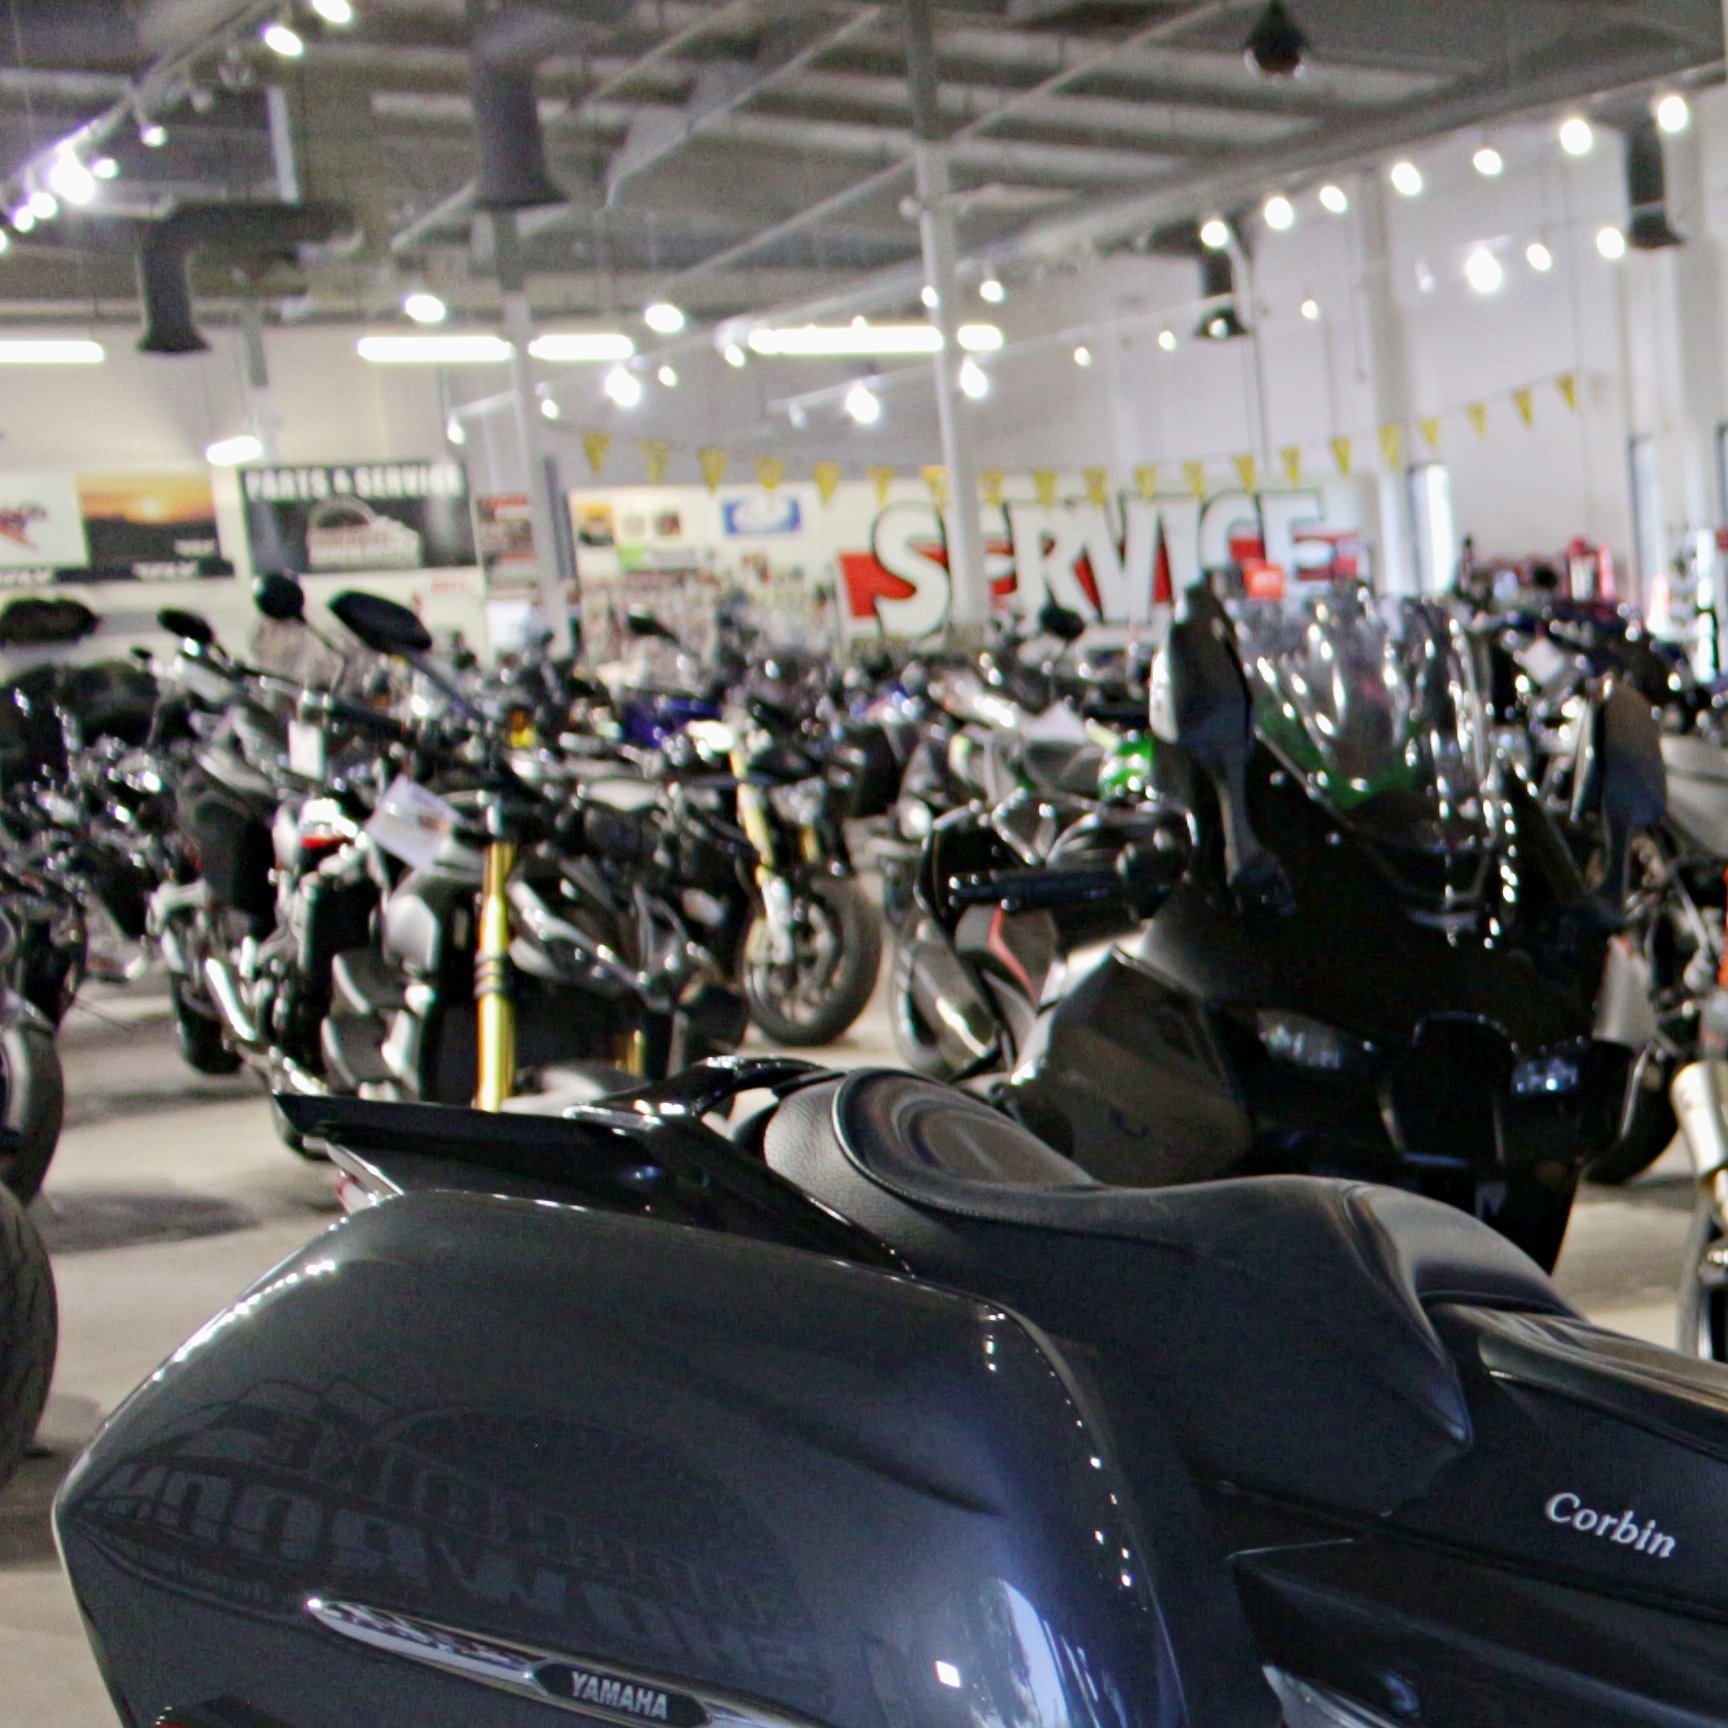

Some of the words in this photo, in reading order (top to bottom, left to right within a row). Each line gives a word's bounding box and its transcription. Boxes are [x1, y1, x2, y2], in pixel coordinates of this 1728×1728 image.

[245, 468, 330, 499] PARTS
[1545, 1492, 1676, 1558] Corbin
[571, 1671, 668, 1720] YAMAHA
